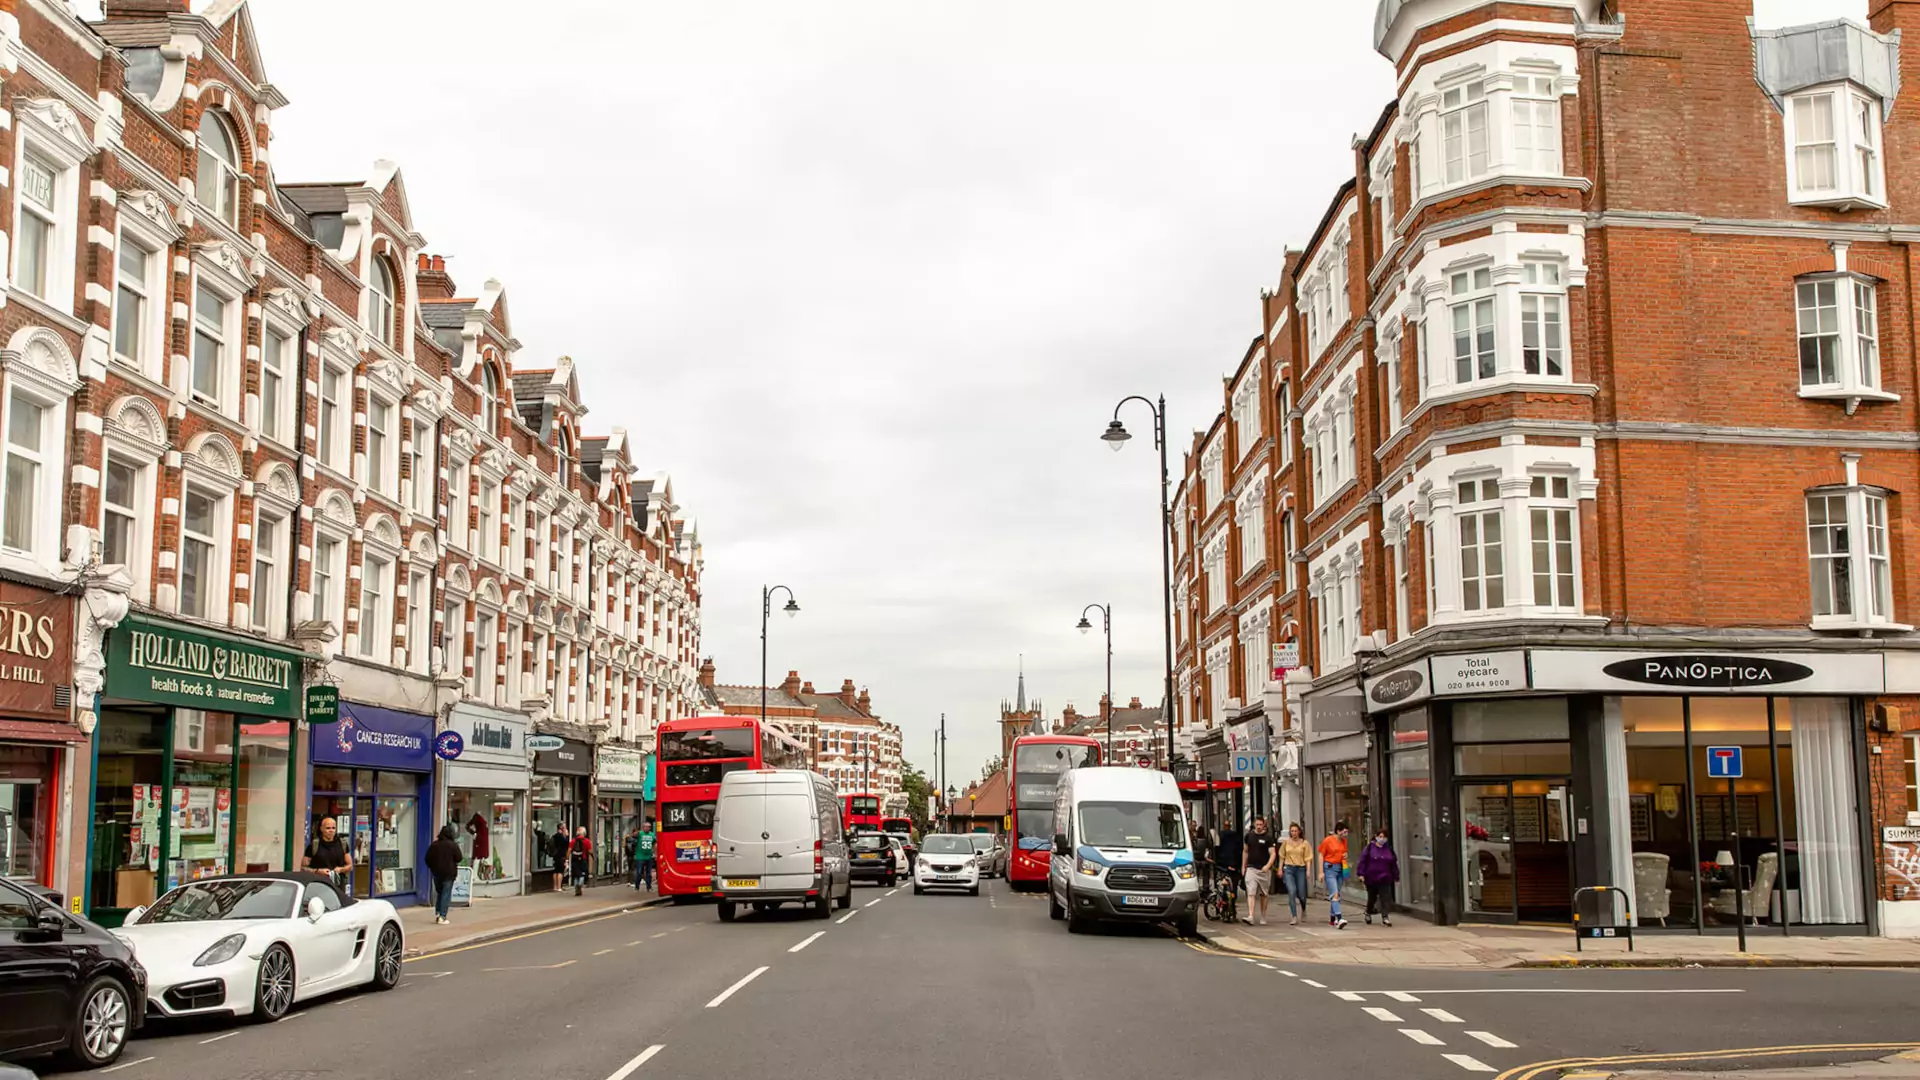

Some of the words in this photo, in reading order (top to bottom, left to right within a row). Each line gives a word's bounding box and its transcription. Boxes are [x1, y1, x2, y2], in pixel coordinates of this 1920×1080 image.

[129, 630, 210, 672] HOLLAND
[212, 646, 228, 680] &
[228, 649, 292, 690] BARRETT
[1465, 658, 1490, 667] Total
[12, 665, 45, 684] HILL
[1457, 668, 1499, 679] eyecare
[1489, 679, 1511, 687] 9008
[151, 676, 178, 692] health
[180, 679, 204, 697] foods
[205, 683, 213, 697] &
[243, 692, 275, 705] remedies
[309, 706, 334, 715] BARRETT
[356, 730, 382, 745] CANCER
[383, 733, 413, 749] RESEARCH
[413, 738, 421, 749] UK
[1237, 757, 1266, 771] DIY
[670, 809, 685, 822] 134
